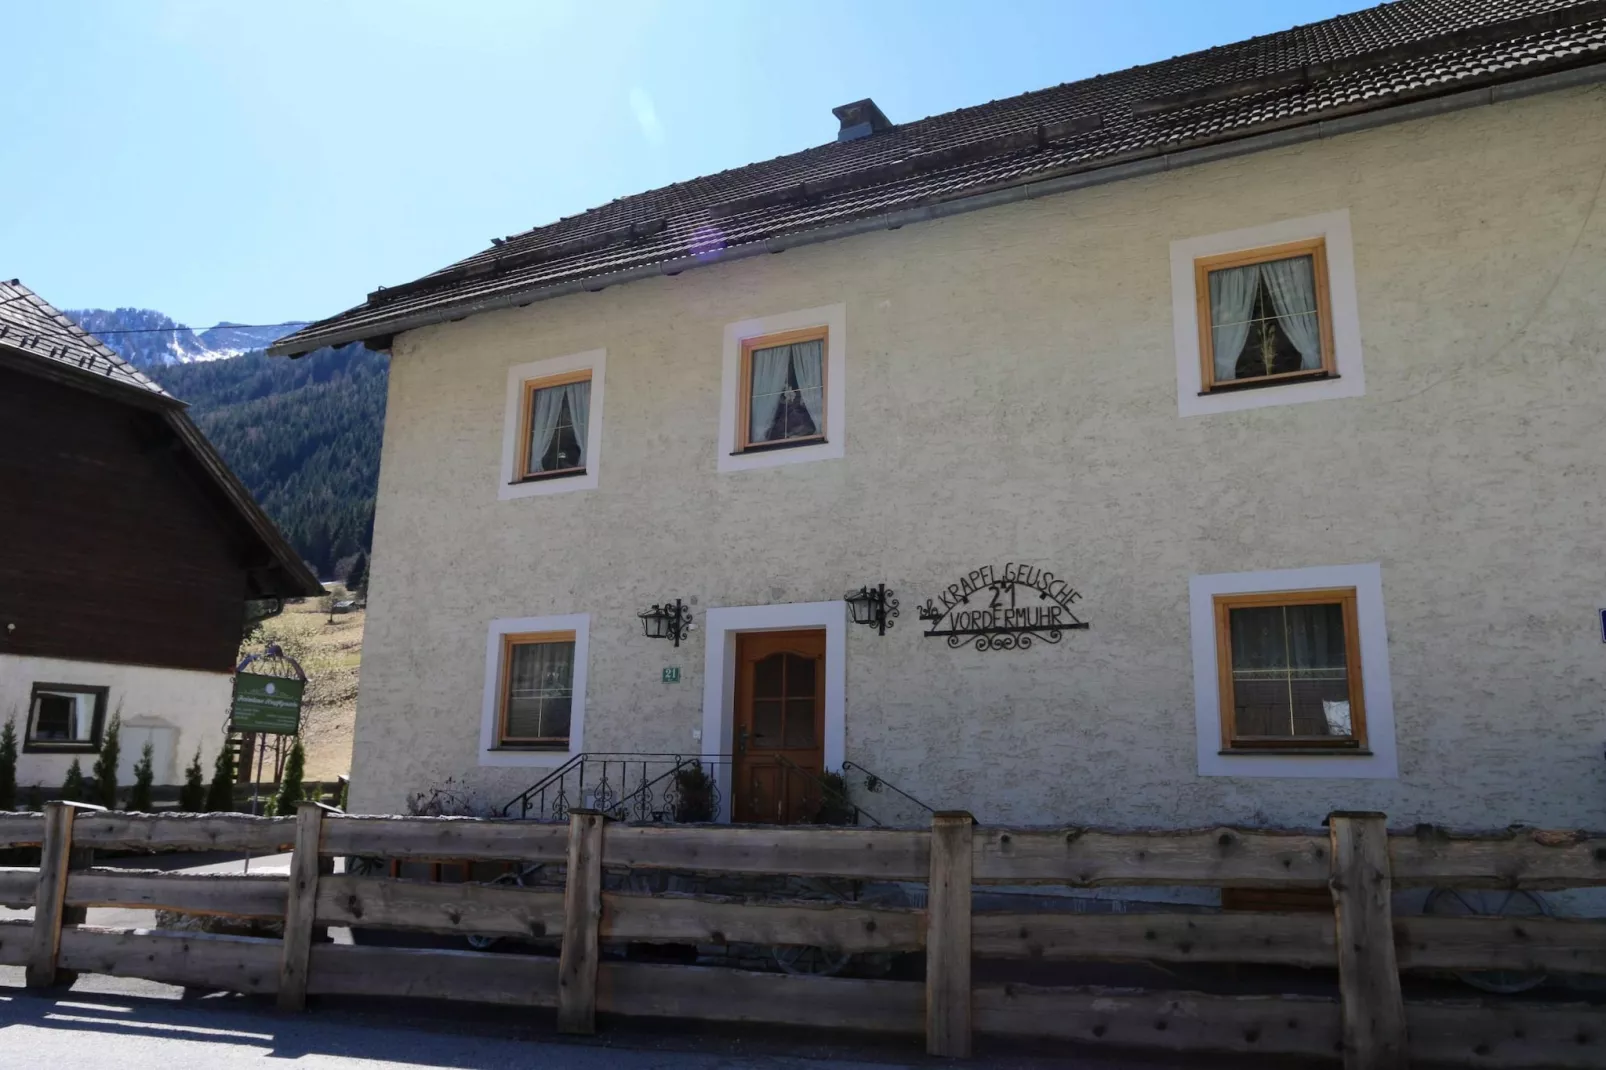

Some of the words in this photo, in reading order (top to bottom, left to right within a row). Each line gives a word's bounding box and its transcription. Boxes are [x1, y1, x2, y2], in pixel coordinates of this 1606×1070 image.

[988, 584, 1015, 609] 21
[950, 606, 1063, 632] VORDERMUHR
[664, 668, 677, 679] 21
